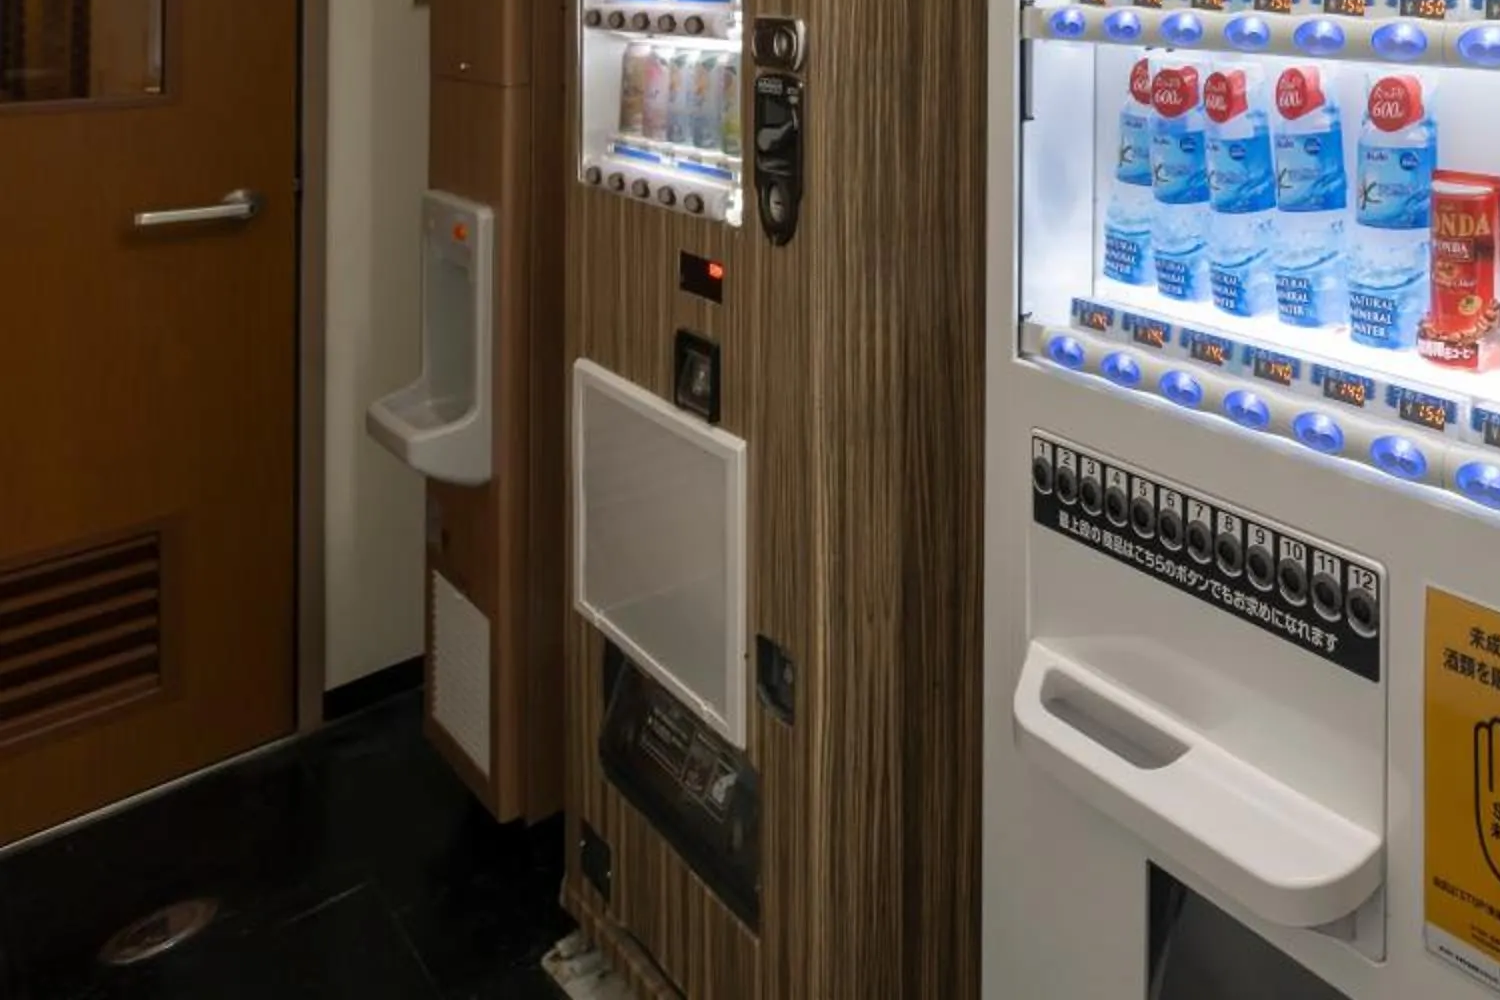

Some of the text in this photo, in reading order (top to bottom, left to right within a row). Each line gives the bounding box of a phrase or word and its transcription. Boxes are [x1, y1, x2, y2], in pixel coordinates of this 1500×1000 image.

[1419, 0, 1445, 16] 150
[1434, 212, 1491, 238] ONDA
[1039, 442, 1046, 455] 1
[1062, 451, 1071, 465] 2
[1087, 461, 1095, 475] 3
[1112, 471, 1121, 484] 4
[1139, 481, 1147, 497] 5
[1167, 491, 1175, 507] 6
[1195, 503, 1204, 518] 7
[1224, 515, 1233, 533] 8
[1256, 529, 1265, 545] 9
[1284, 541, 1303, 561] 10
[1318, 555, 1335, 574] 11
[1353, 569, 1374, 591] 12
